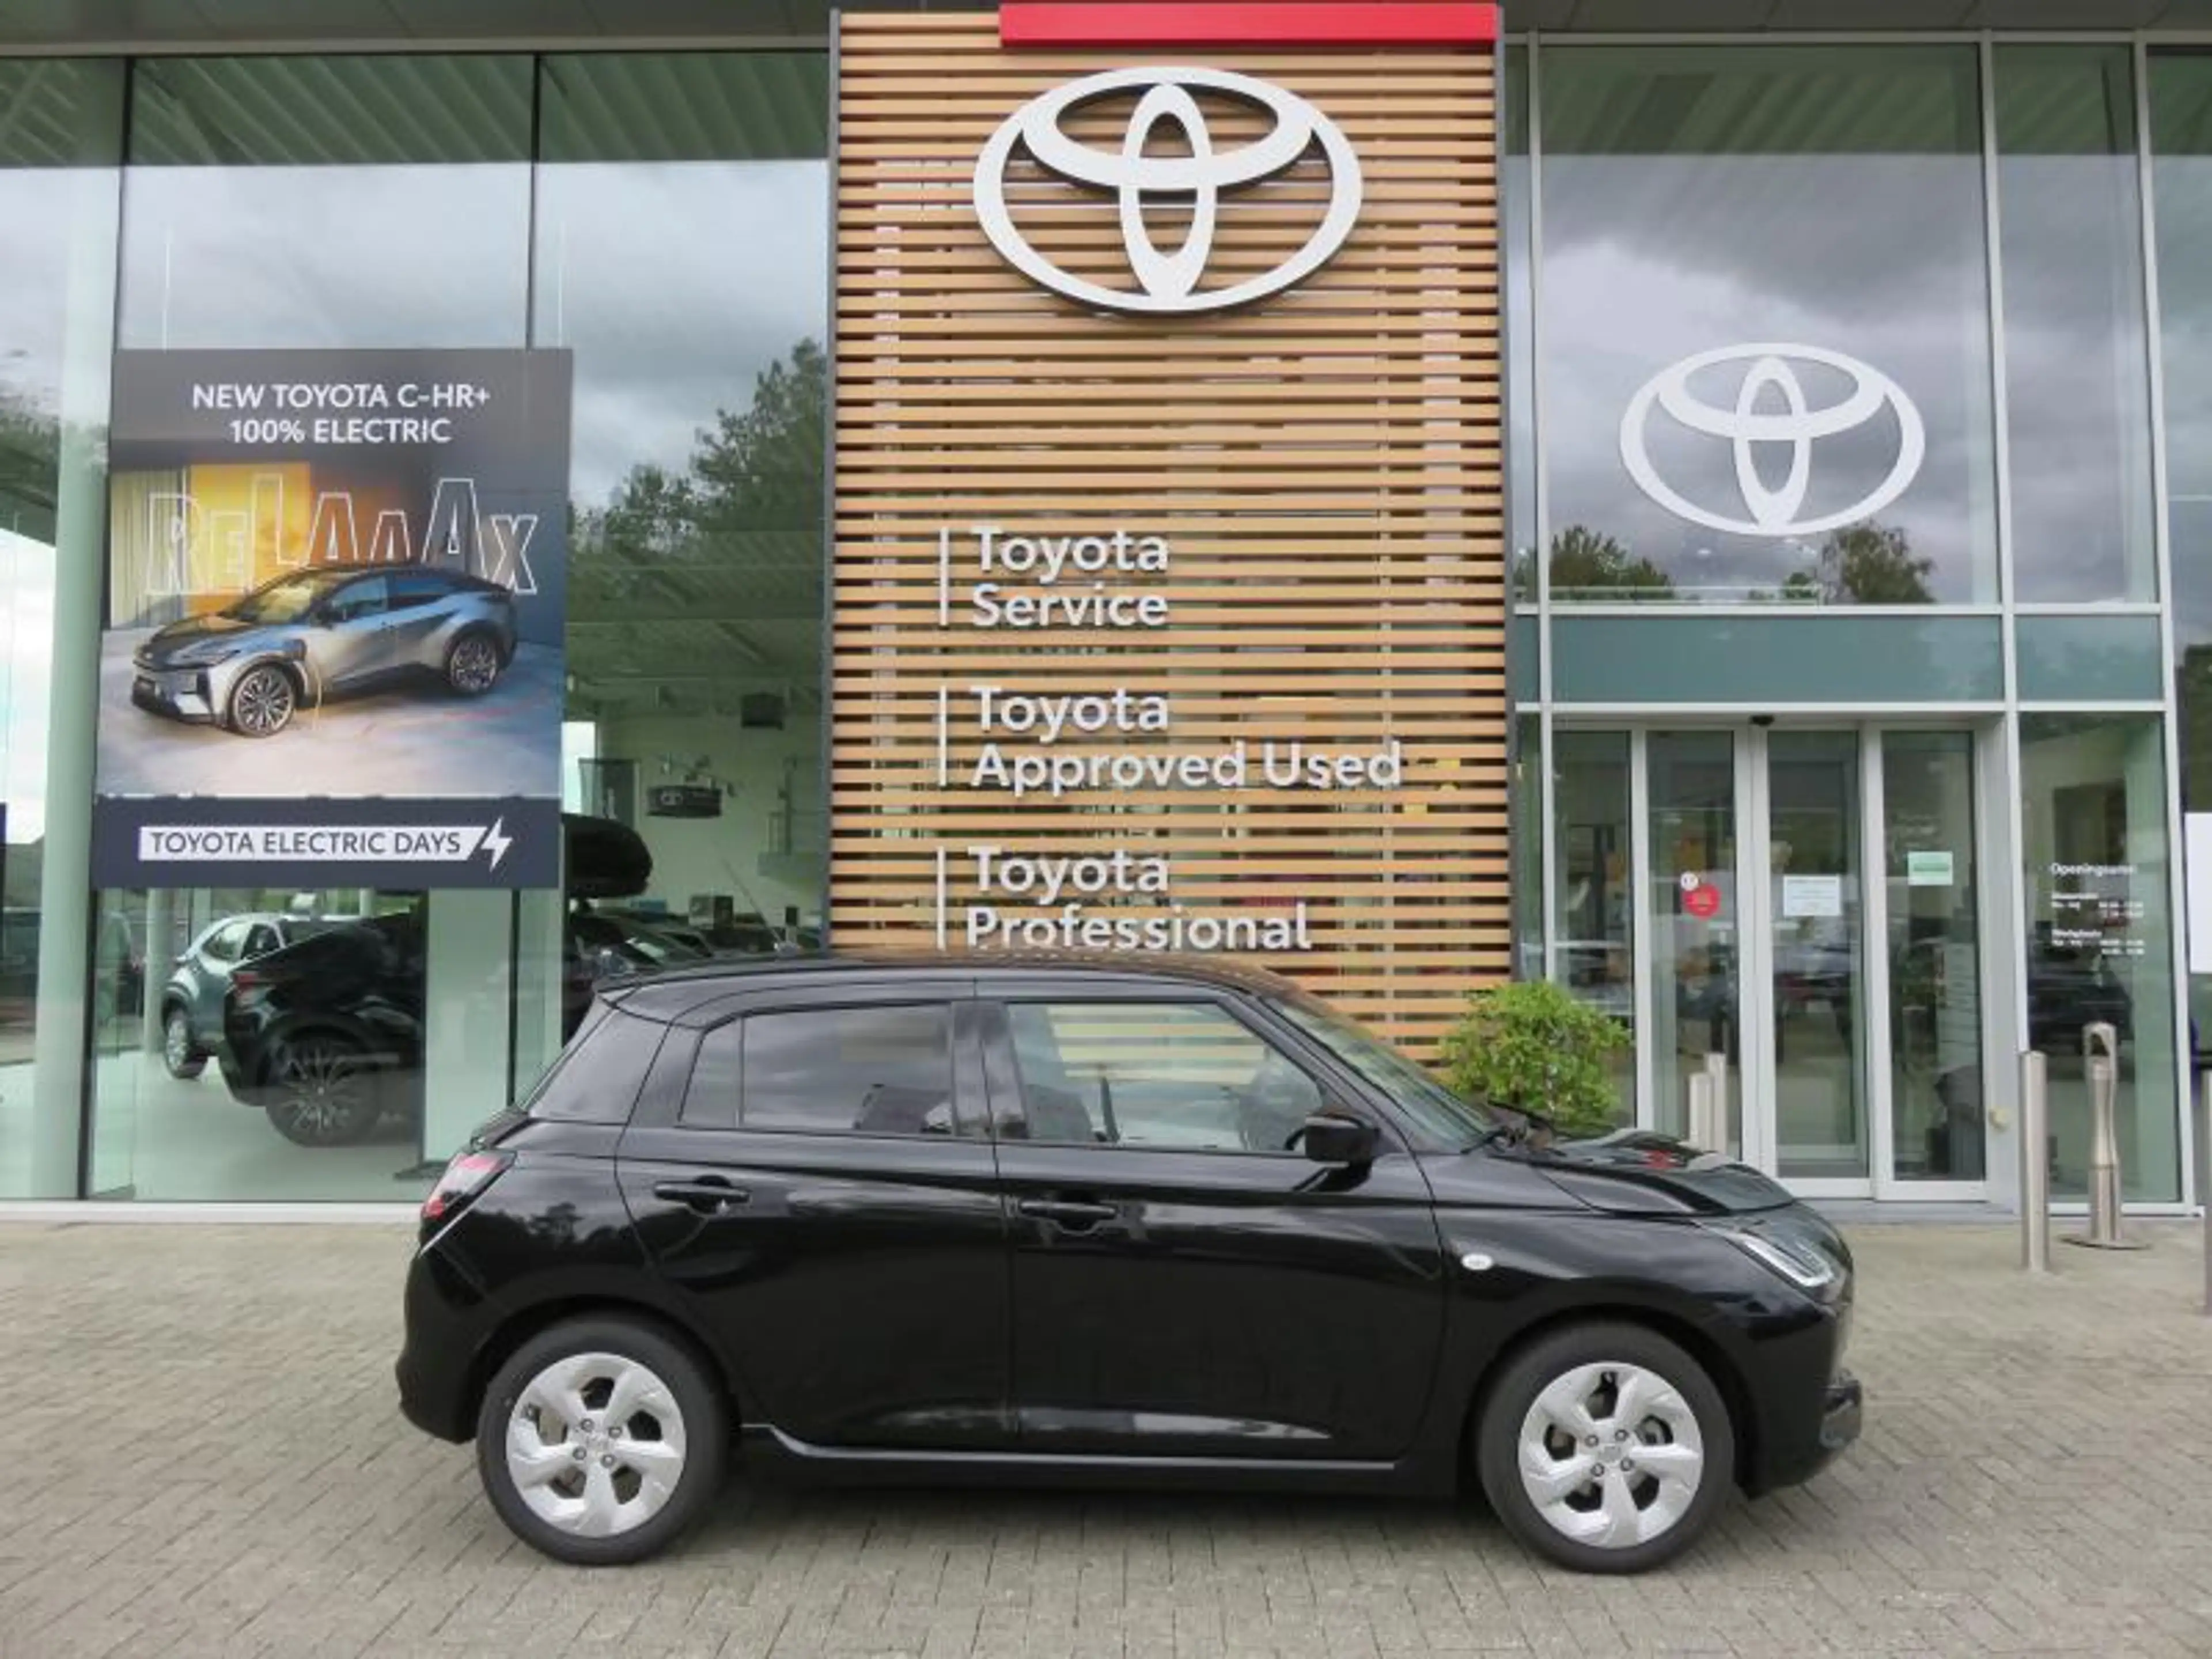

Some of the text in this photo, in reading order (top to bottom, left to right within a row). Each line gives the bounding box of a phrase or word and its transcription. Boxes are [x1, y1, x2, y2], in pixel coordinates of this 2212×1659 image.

[192, 384, 491, 408] NEW TOYOTA C-HR+
[230, 419, 452, 444] 100% ELECTRIC
[971, 526, 1169, 583] Toyota
[972, 582, 1169, 626] Service
[971, 685, 1169, 743] Toyota
[972, 741, 1402, 797] Approved Used
[151, 832, 461, 854] TOYOTA ELECTRIC DAYS
[968, 846, 1169, 905] Toyota
[967, 903, 1312, 950] Professional
